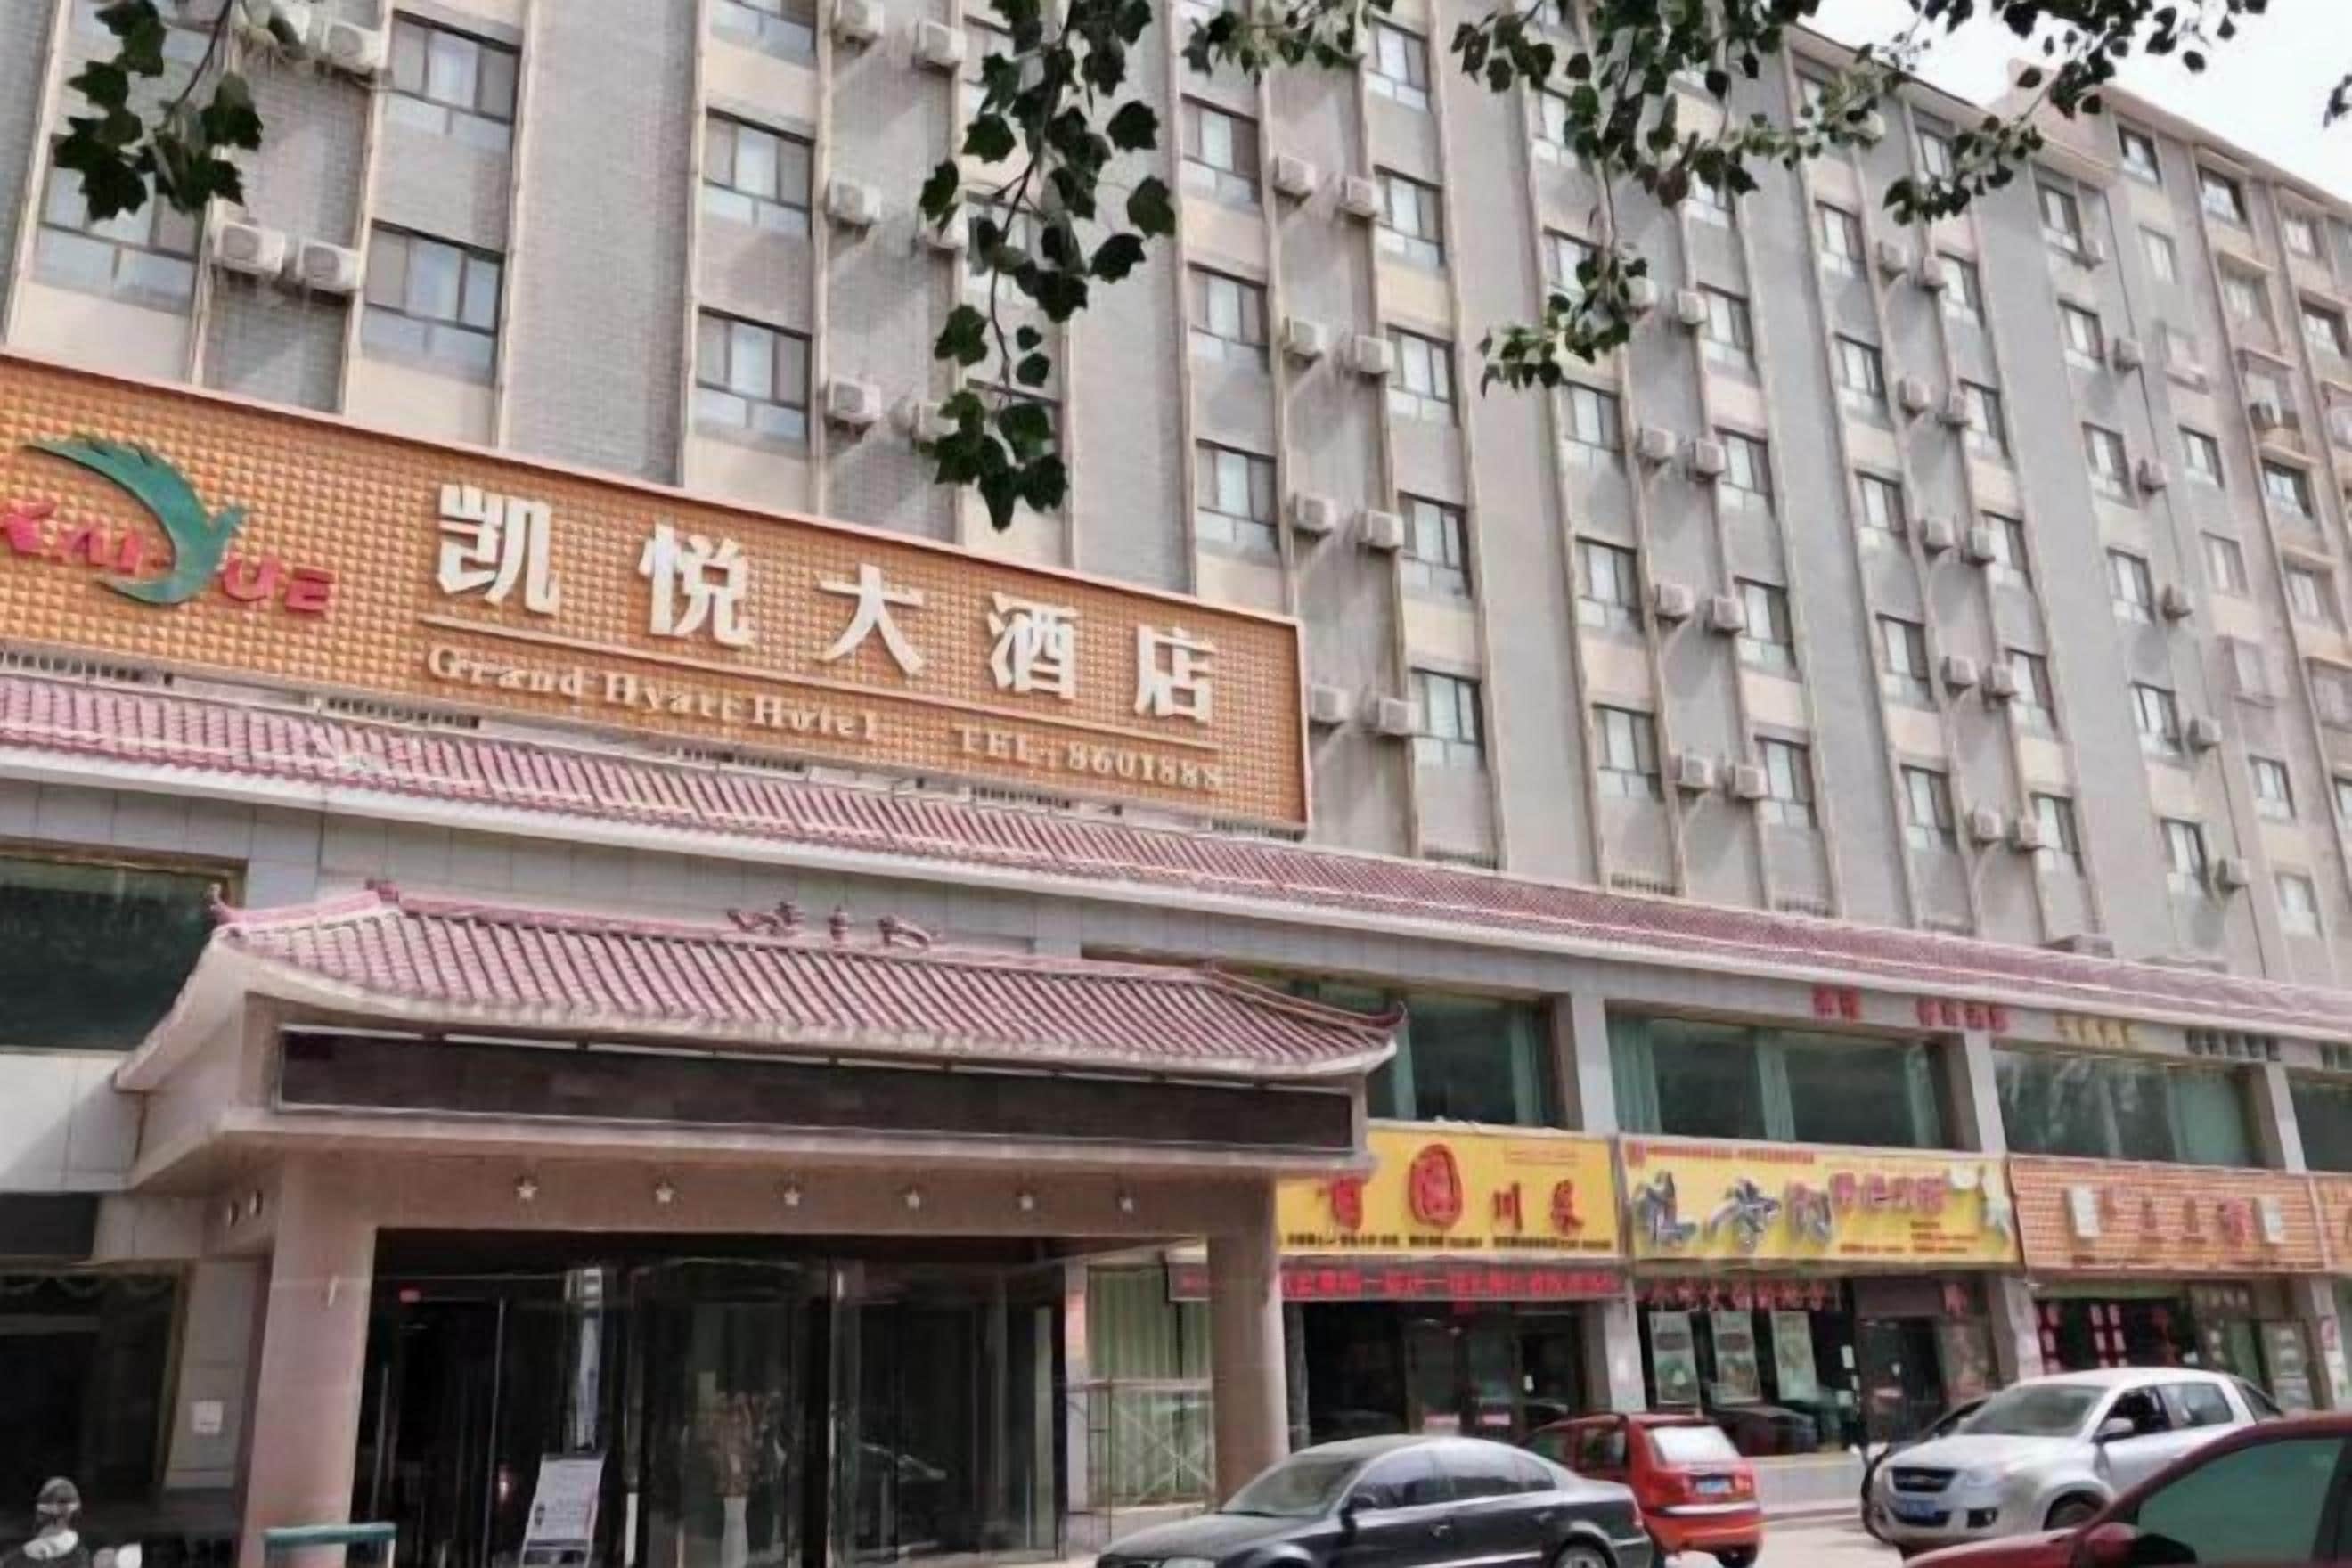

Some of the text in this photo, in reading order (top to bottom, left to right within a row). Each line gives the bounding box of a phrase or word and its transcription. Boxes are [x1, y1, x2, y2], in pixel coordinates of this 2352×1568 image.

[429, 643, 584, 698] Grand
[436, 483, 1215, 723] 凯悦大酒店
